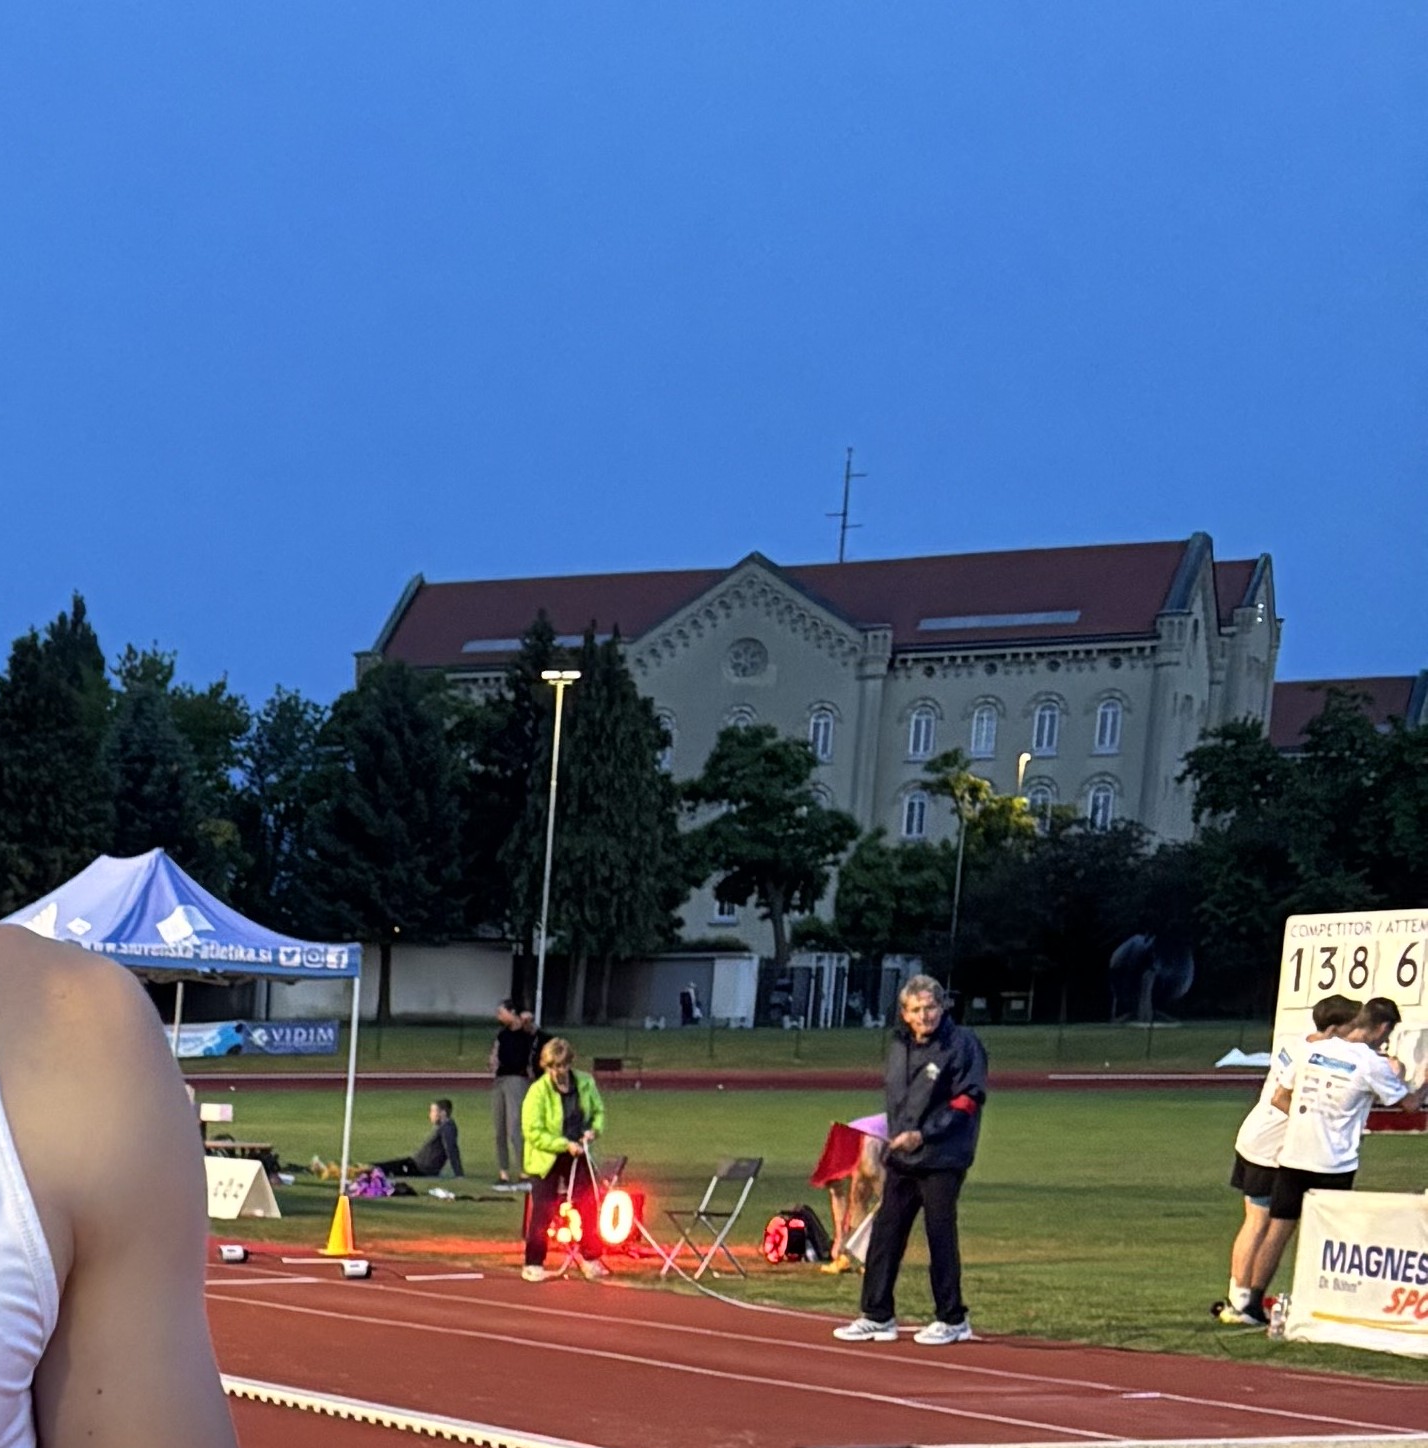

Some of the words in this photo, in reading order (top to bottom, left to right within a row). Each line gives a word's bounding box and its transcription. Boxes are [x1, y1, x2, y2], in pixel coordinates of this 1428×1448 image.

[1291, 921, 1373, 938] COMPETITOR
[1396, 941, 1419, 987] 6
[271, 1027, 334, 1042] VIDIM
